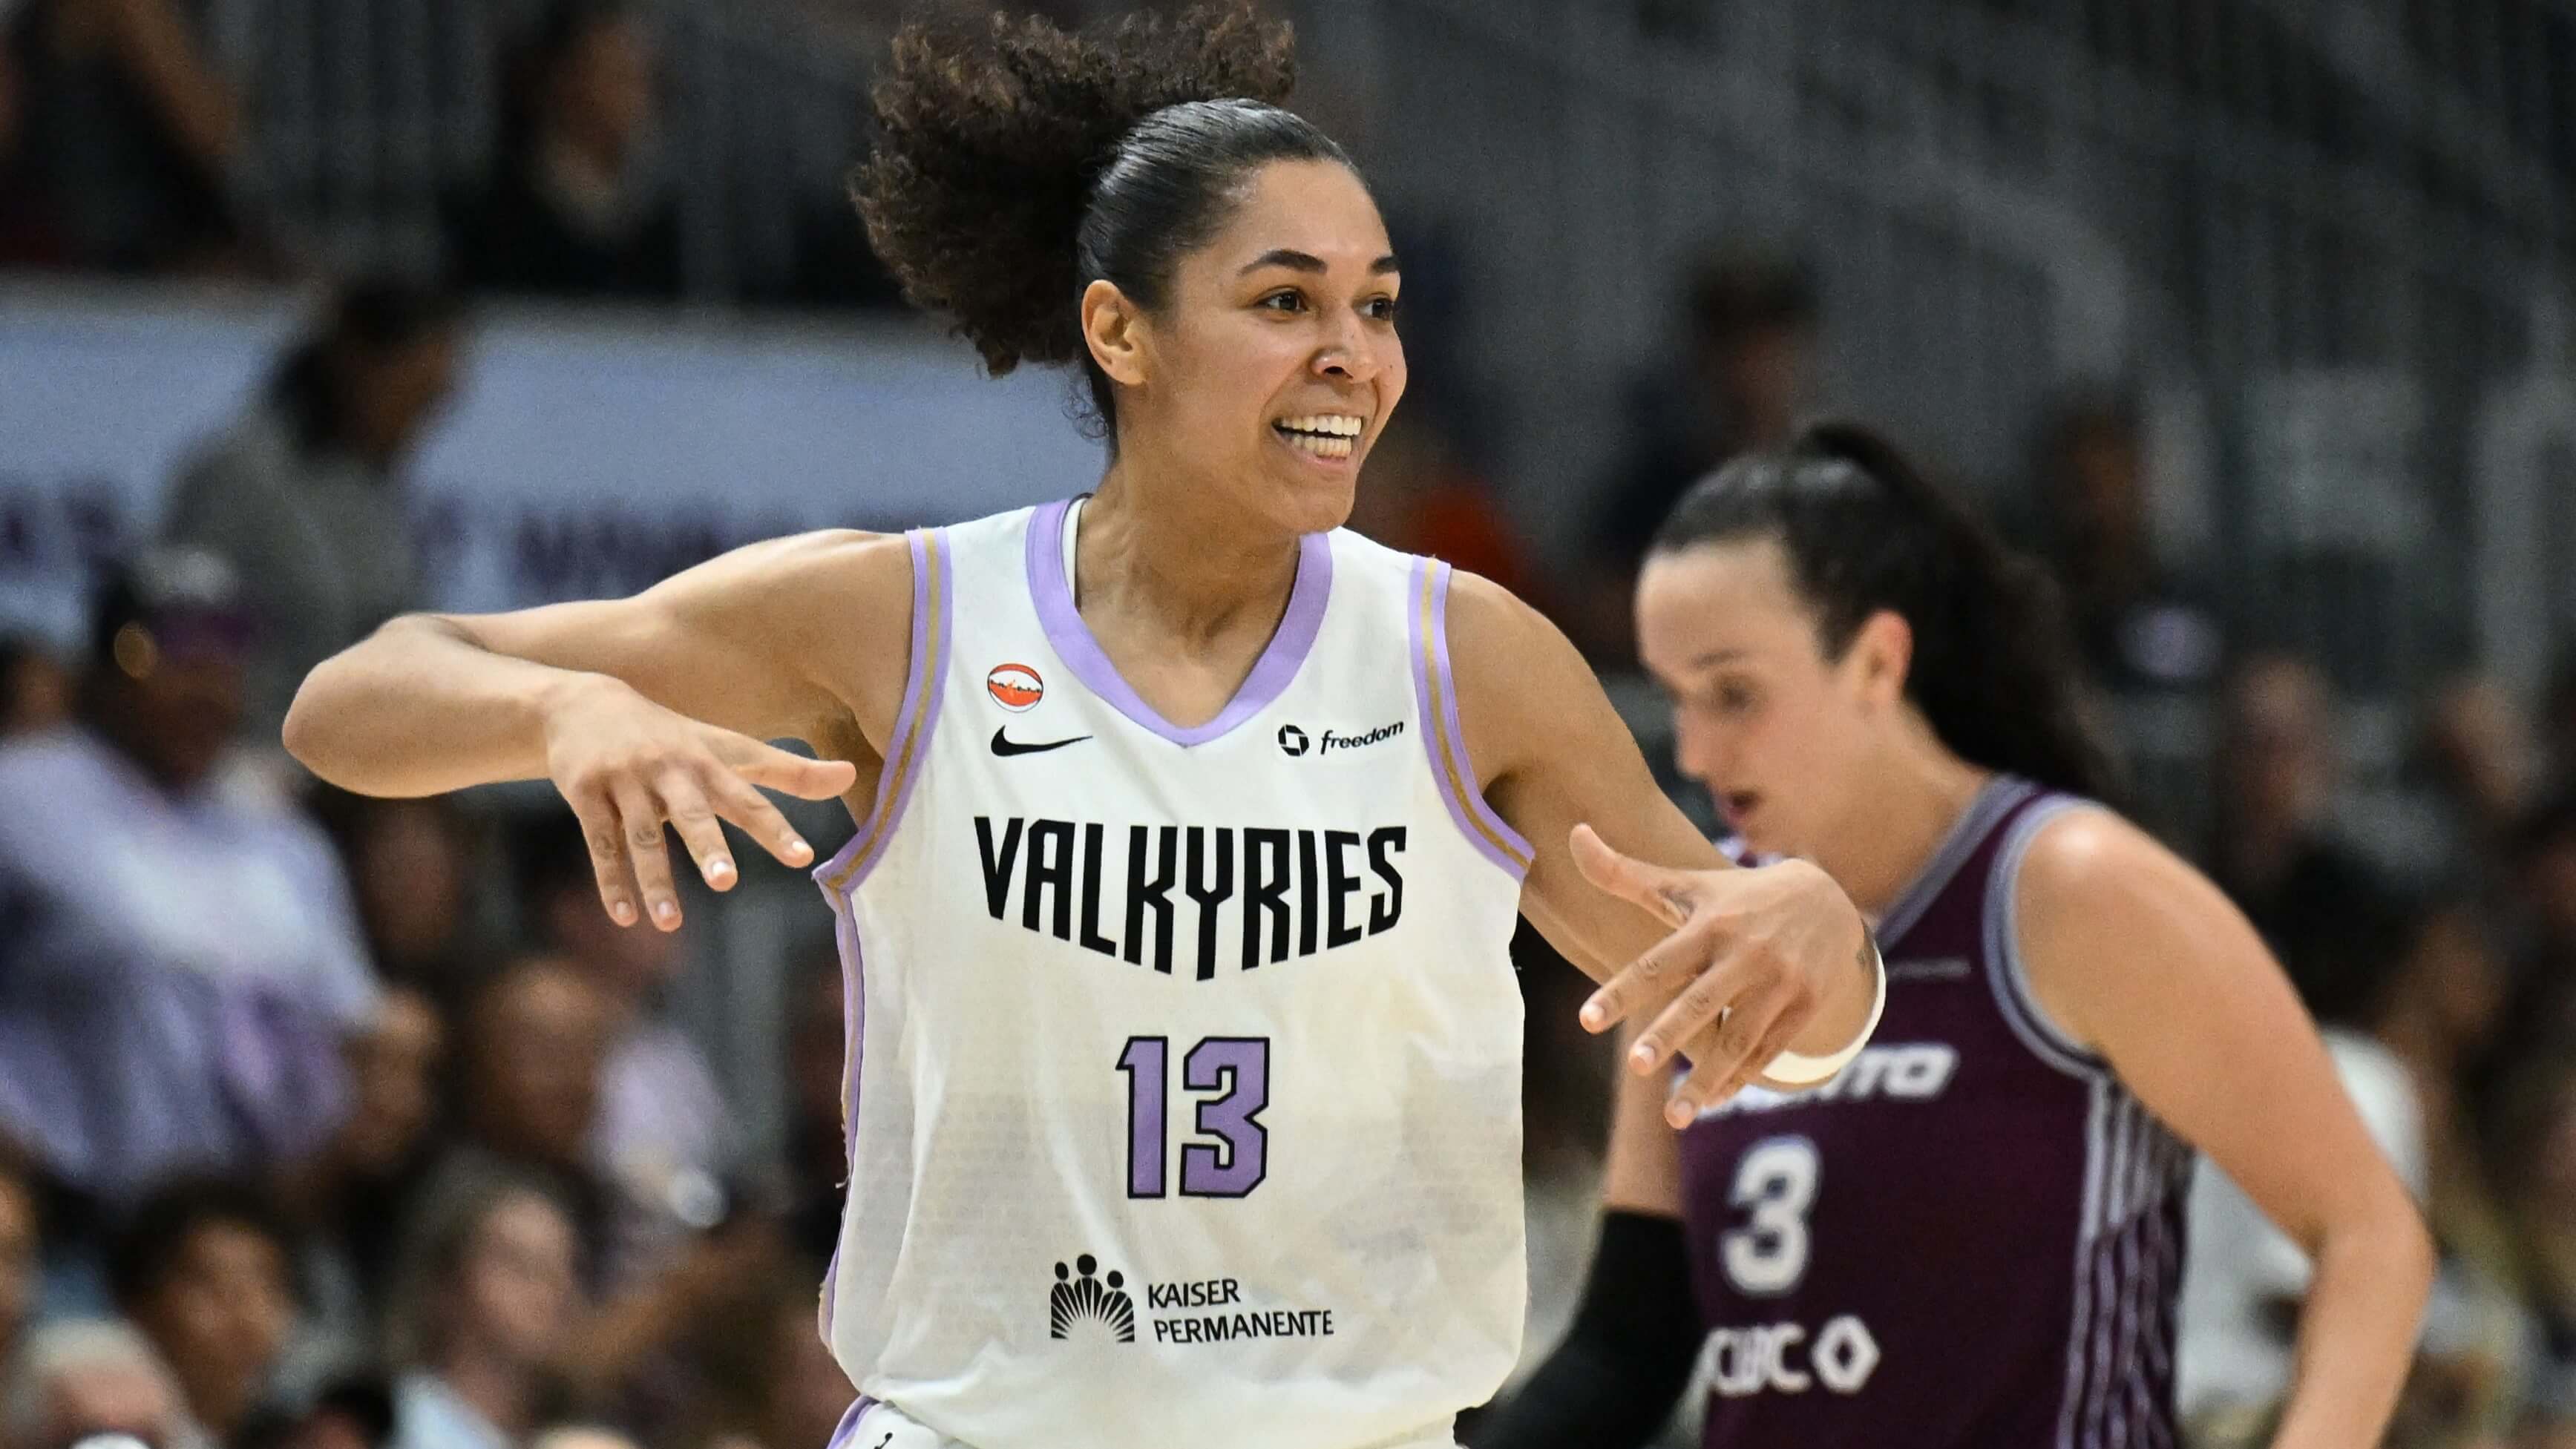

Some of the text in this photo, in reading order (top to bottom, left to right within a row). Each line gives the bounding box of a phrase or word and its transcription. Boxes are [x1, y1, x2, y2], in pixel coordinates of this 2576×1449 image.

[1321, 722, 1403, 755] freedom
[974, 817, 1406, 981] VALKYRIES
[1115, 1036, 1270, 1199] 13
[1724, 1136, 1818, 1292] 3
[1149, 1279, 1240, 1309] KAISER
[1154, 1310, 1334, 1343] PERMANENTE
